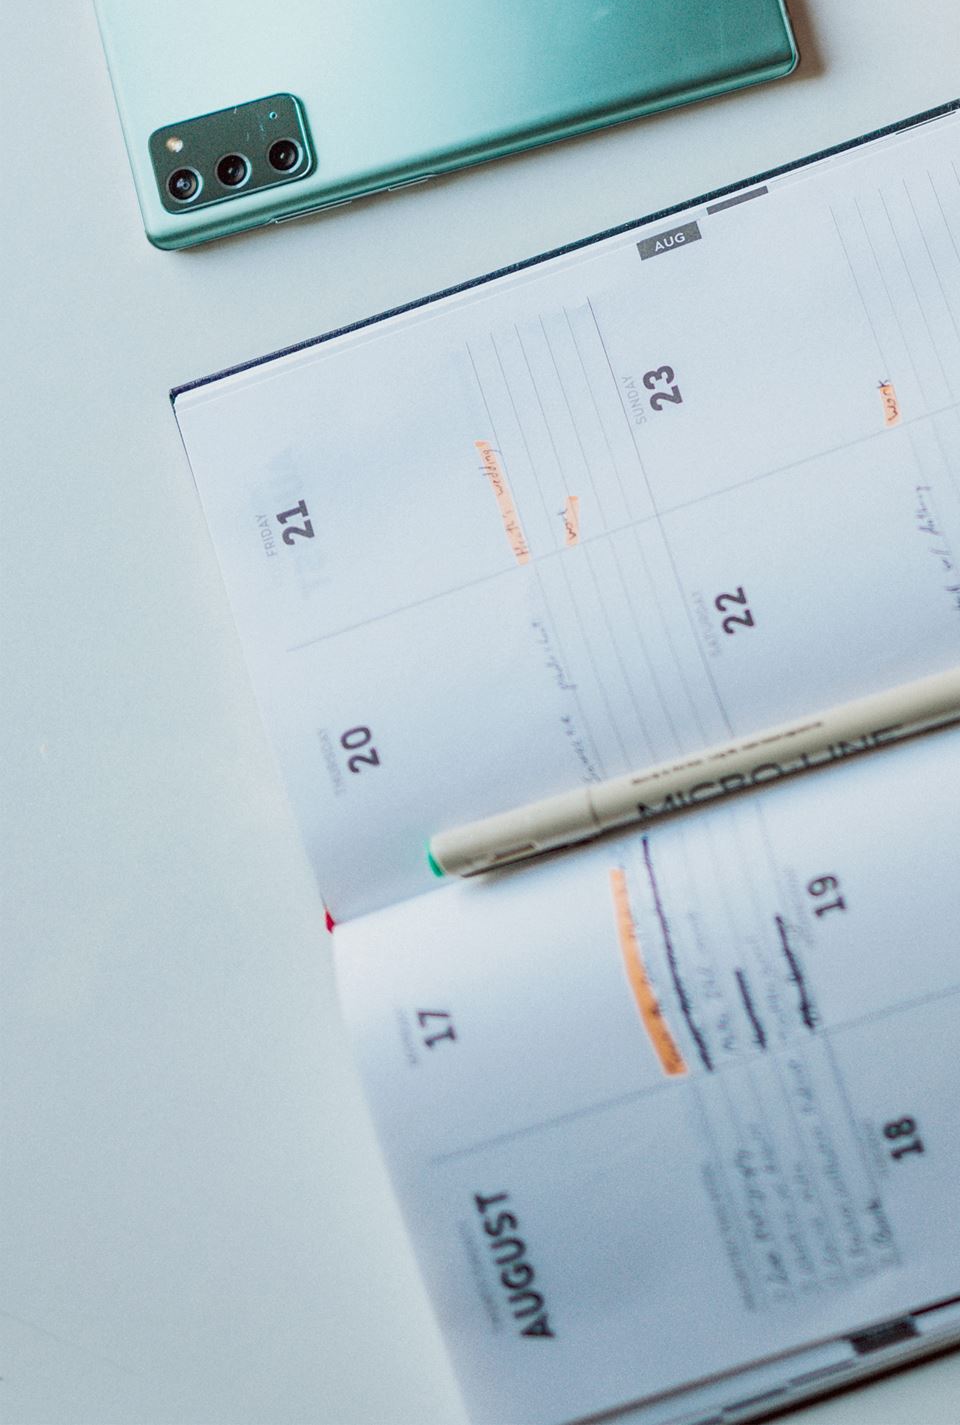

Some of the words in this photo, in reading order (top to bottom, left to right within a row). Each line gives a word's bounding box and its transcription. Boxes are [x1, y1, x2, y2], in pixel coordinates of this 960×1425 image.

[654, 232, 689, 252] AUG
[621, 375, 647, 425] SUNDAY
[642, 365, 683, 411] 23
[255, 513, 277, 557] FRIDAY
[275, 499, 315, 545] 21
[714, 586, 755, 635] 22
[318, 729, 347, 797] THURSDAY
[340, 726, 380, 773] 20
[807, 875, 846, 917] 19
[417, 1010, 457, 1048] 17
[883, 1117, 924, 1160] 18
[474, 1189, 555, 1338] AUGUST
